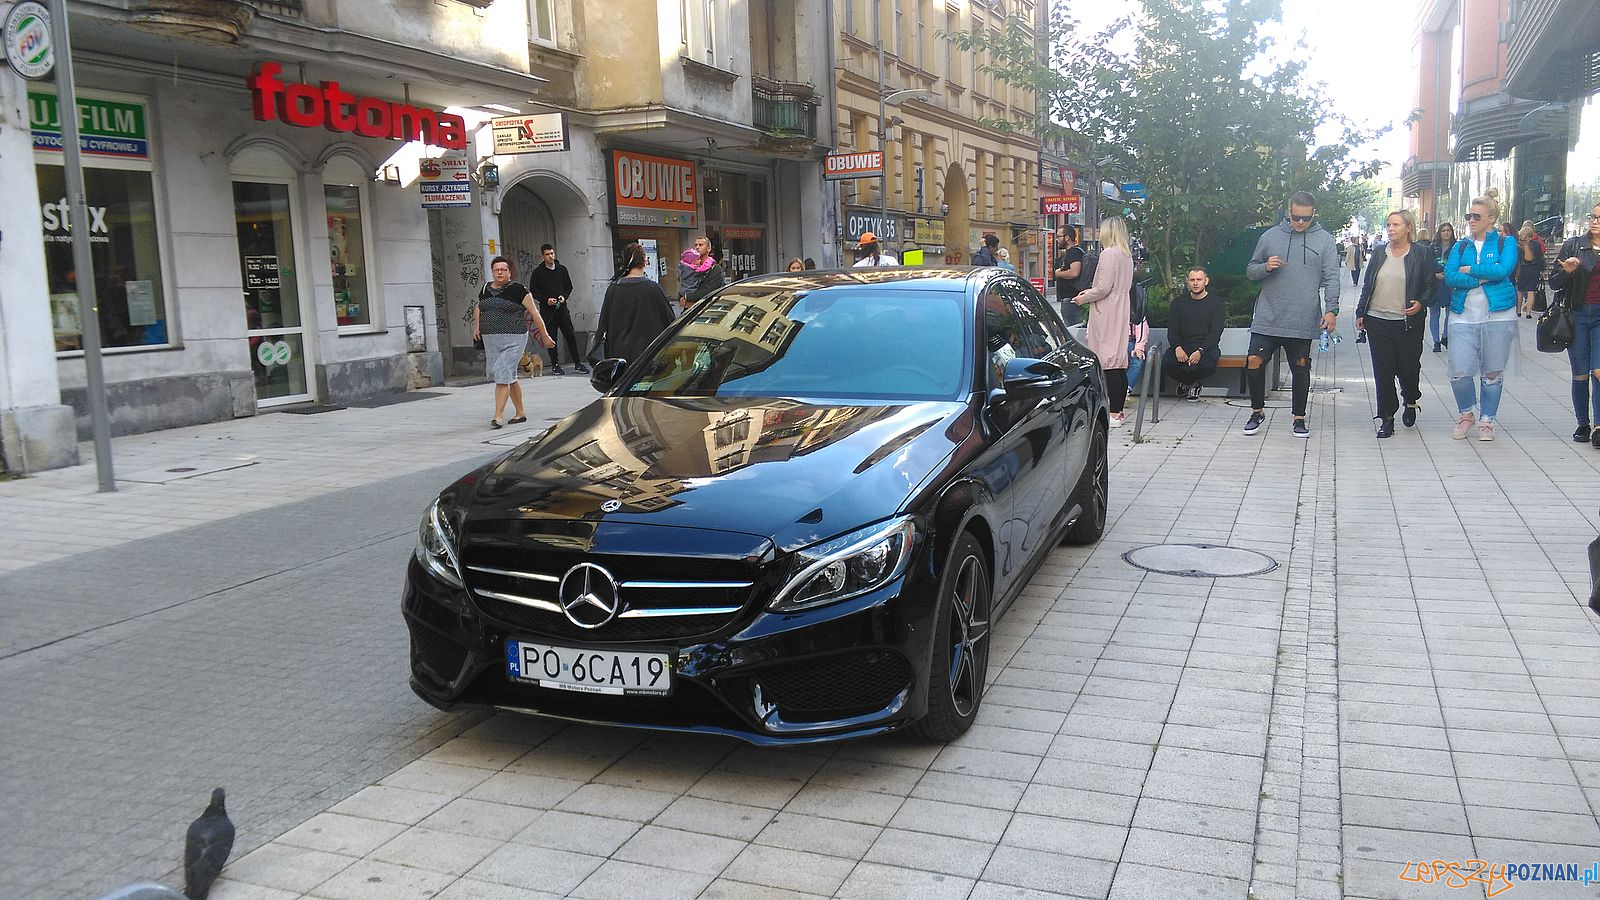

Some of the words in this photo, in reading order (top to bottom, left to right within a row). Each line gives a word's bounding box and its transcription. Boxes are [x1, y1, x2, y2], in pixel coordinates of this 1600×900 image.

[246, 61, 467, 151] fotoma
[28, 99, 136, 134] UJFILM
[89, 140, 138, 152] CYFROWEJ
[441, 158, 467, 167] ŚWIAT
[827, 153, 881, 171] OBUWIE
[617, 156, 694, 203] OBUWIE
[440, 184, 470, 193] JĘZYKOWE
[424, 194, 467, 202] TŁUMACZENIA
[1045, 203, 1077, 213] VENUS
[619, 211, 637, 222] Shoes
[637, 212, 646, 222] for
[849, 216, 883, 237] OPTYK
[509, 662, 519, 672] PL
[522, 647, 560, 678] PO
[571, 653, 664, 687] 6CA19
